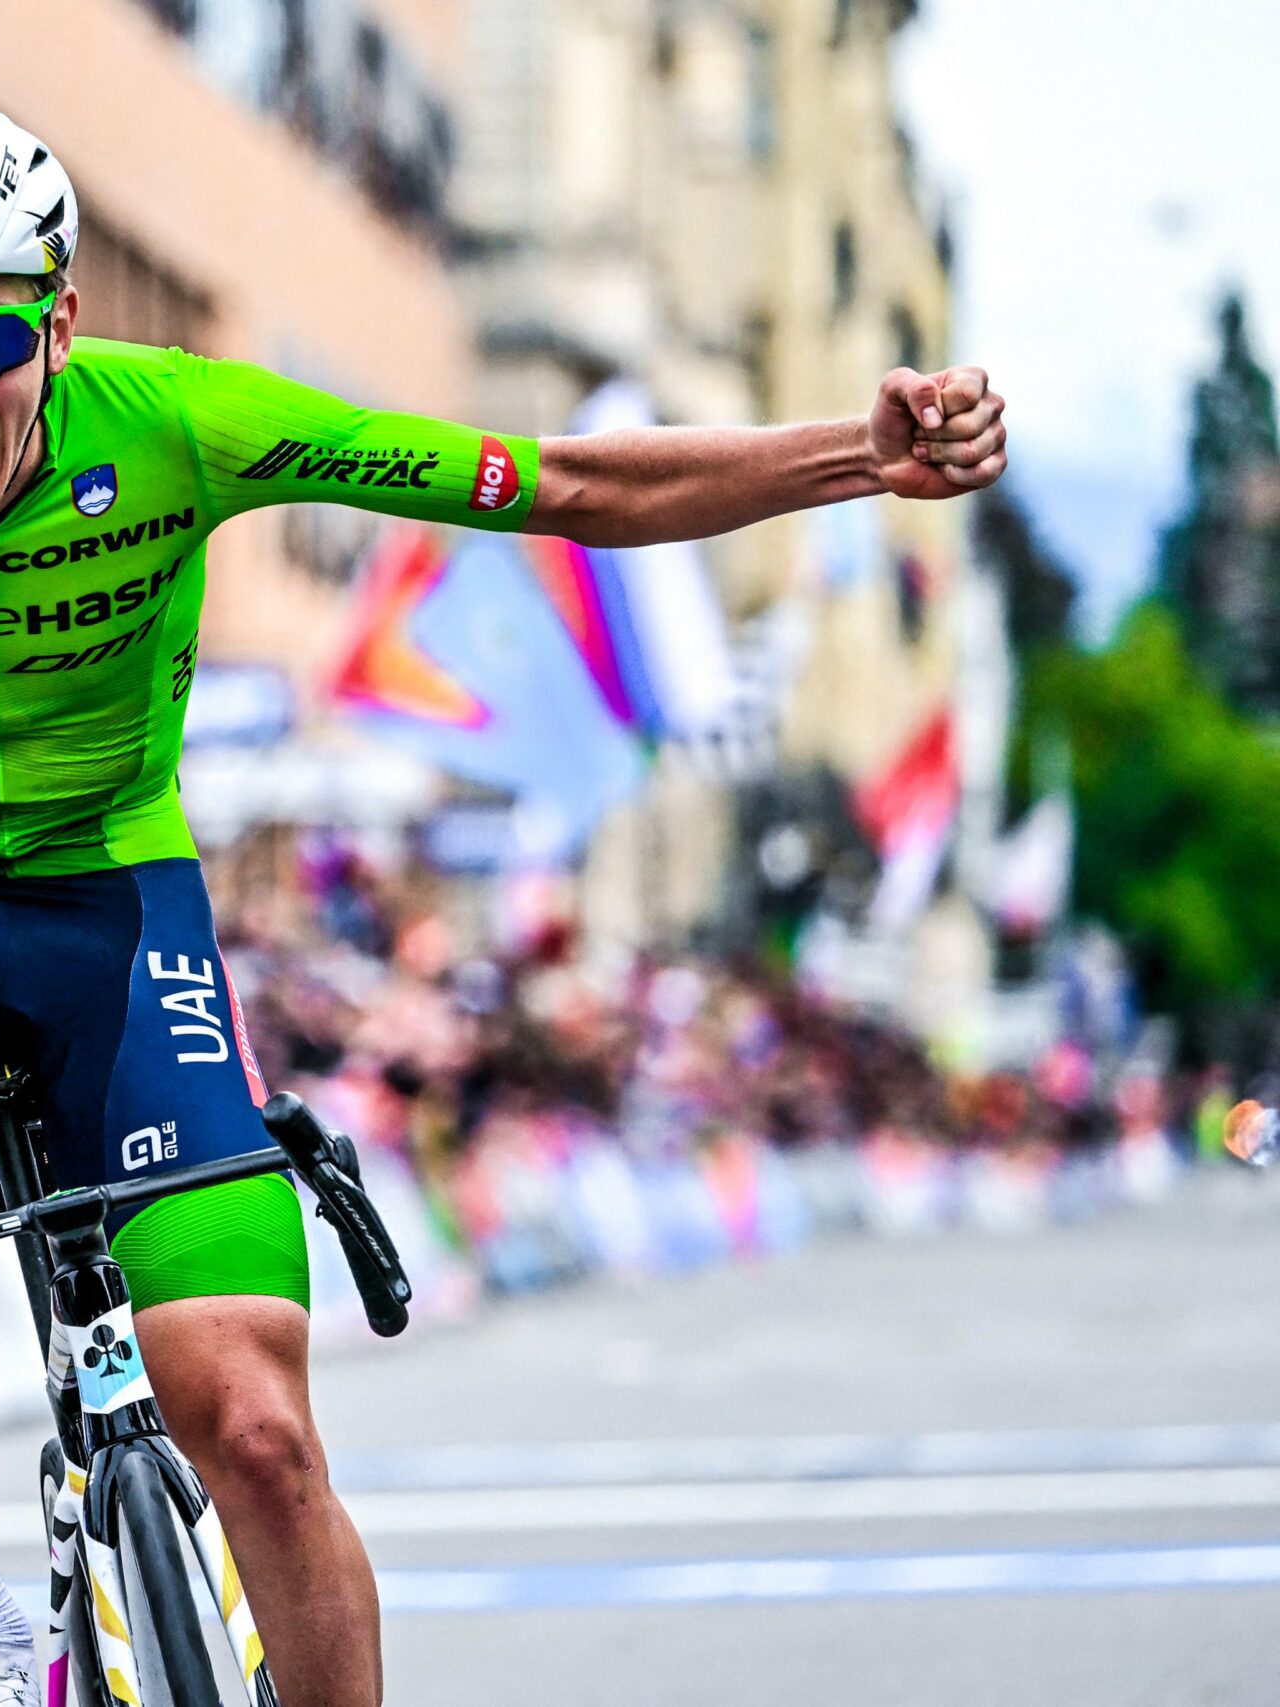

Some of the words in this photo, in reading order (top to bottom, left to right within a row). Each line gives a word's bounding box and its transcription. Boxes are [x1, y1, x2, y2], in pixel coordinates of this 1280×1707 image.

[314, 447, 415, 459] AVTOHIŠA
[478, 454, 506, 508] MOL
[147, 951, 229, 1064] UAE
